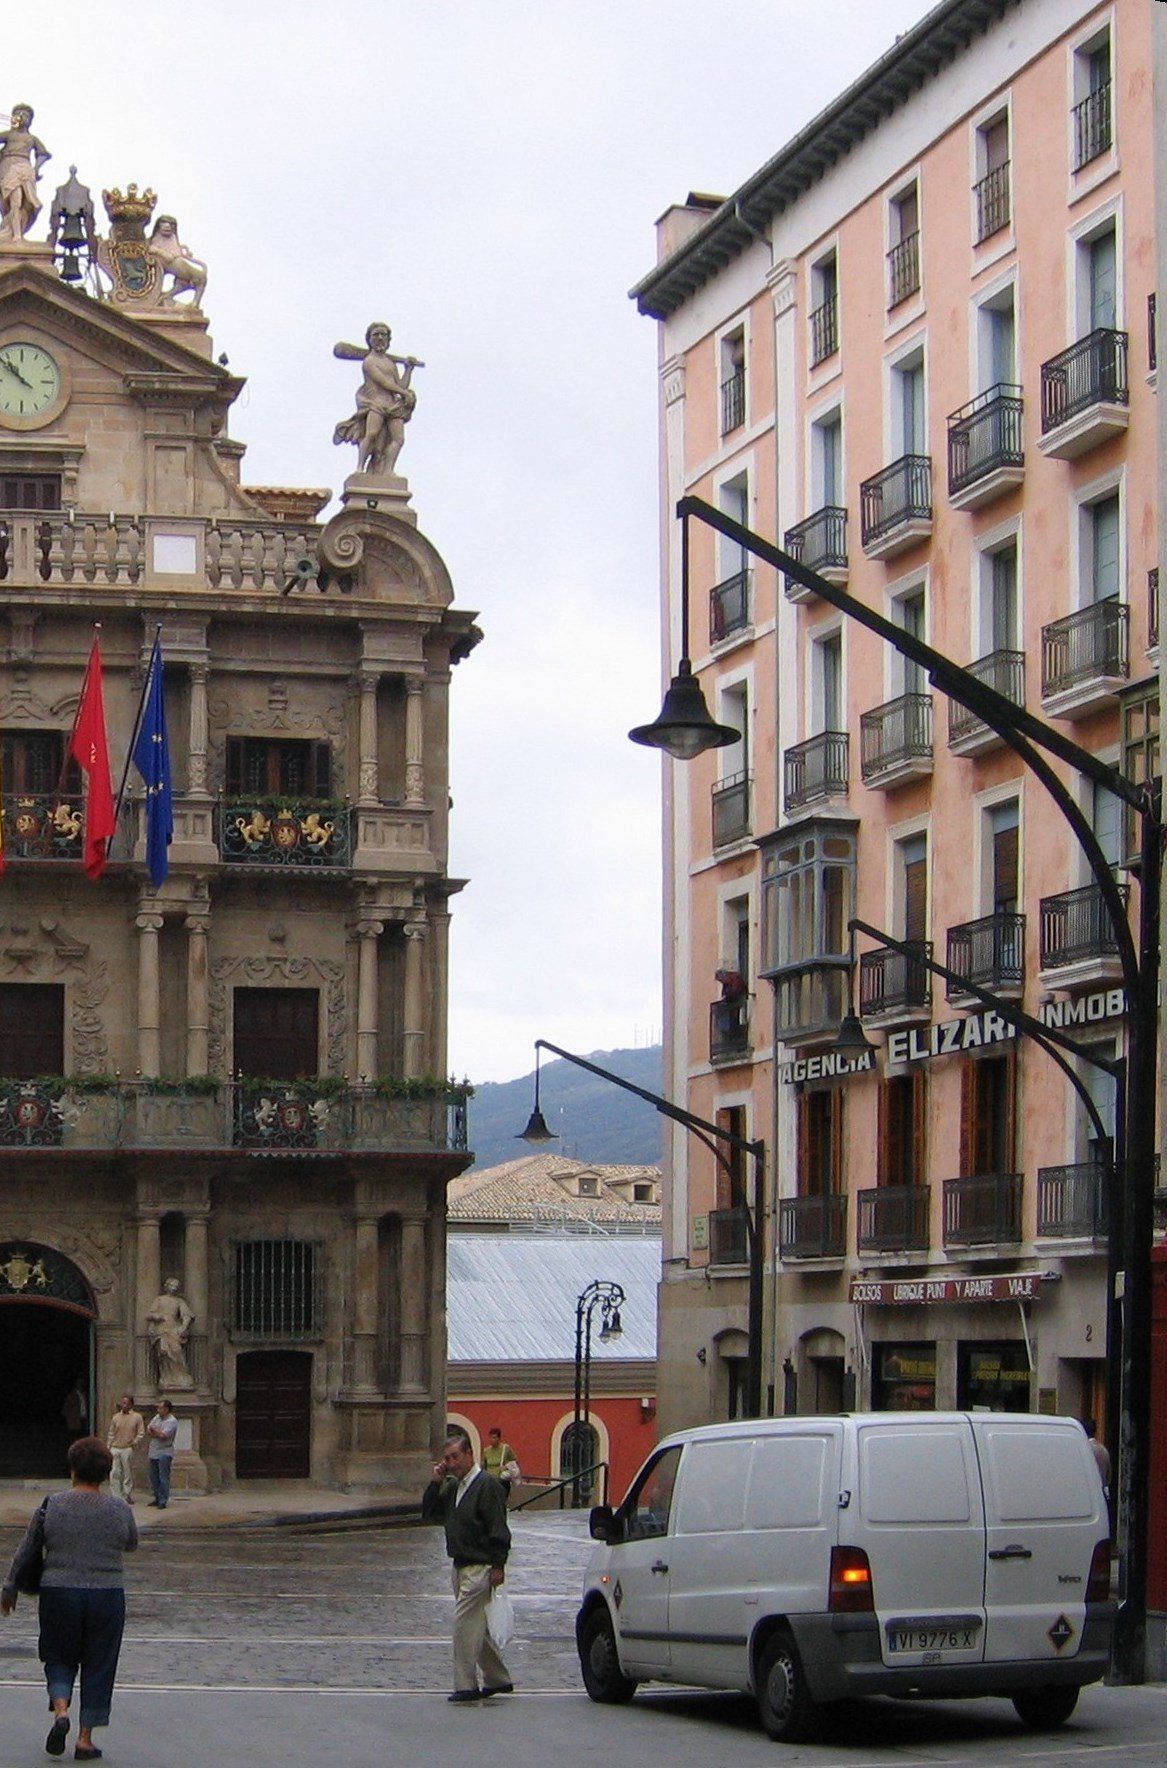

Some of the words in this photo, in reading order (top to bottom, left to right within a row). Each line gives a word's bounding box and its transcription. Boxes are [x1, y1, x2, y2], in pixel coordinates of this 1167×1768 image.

[1038, 988, 1130, 1028] INMOB
[853, 1285, 882, 1300] BOLSOS
[955, 1281, 962, 1297] Y
[1085, 1324, 1092, 1342] 2
[899, 1631, 912, 1649] VI
[918, 1631, 958, 1648] 9776
[963, 1630, 971, 1646] X
